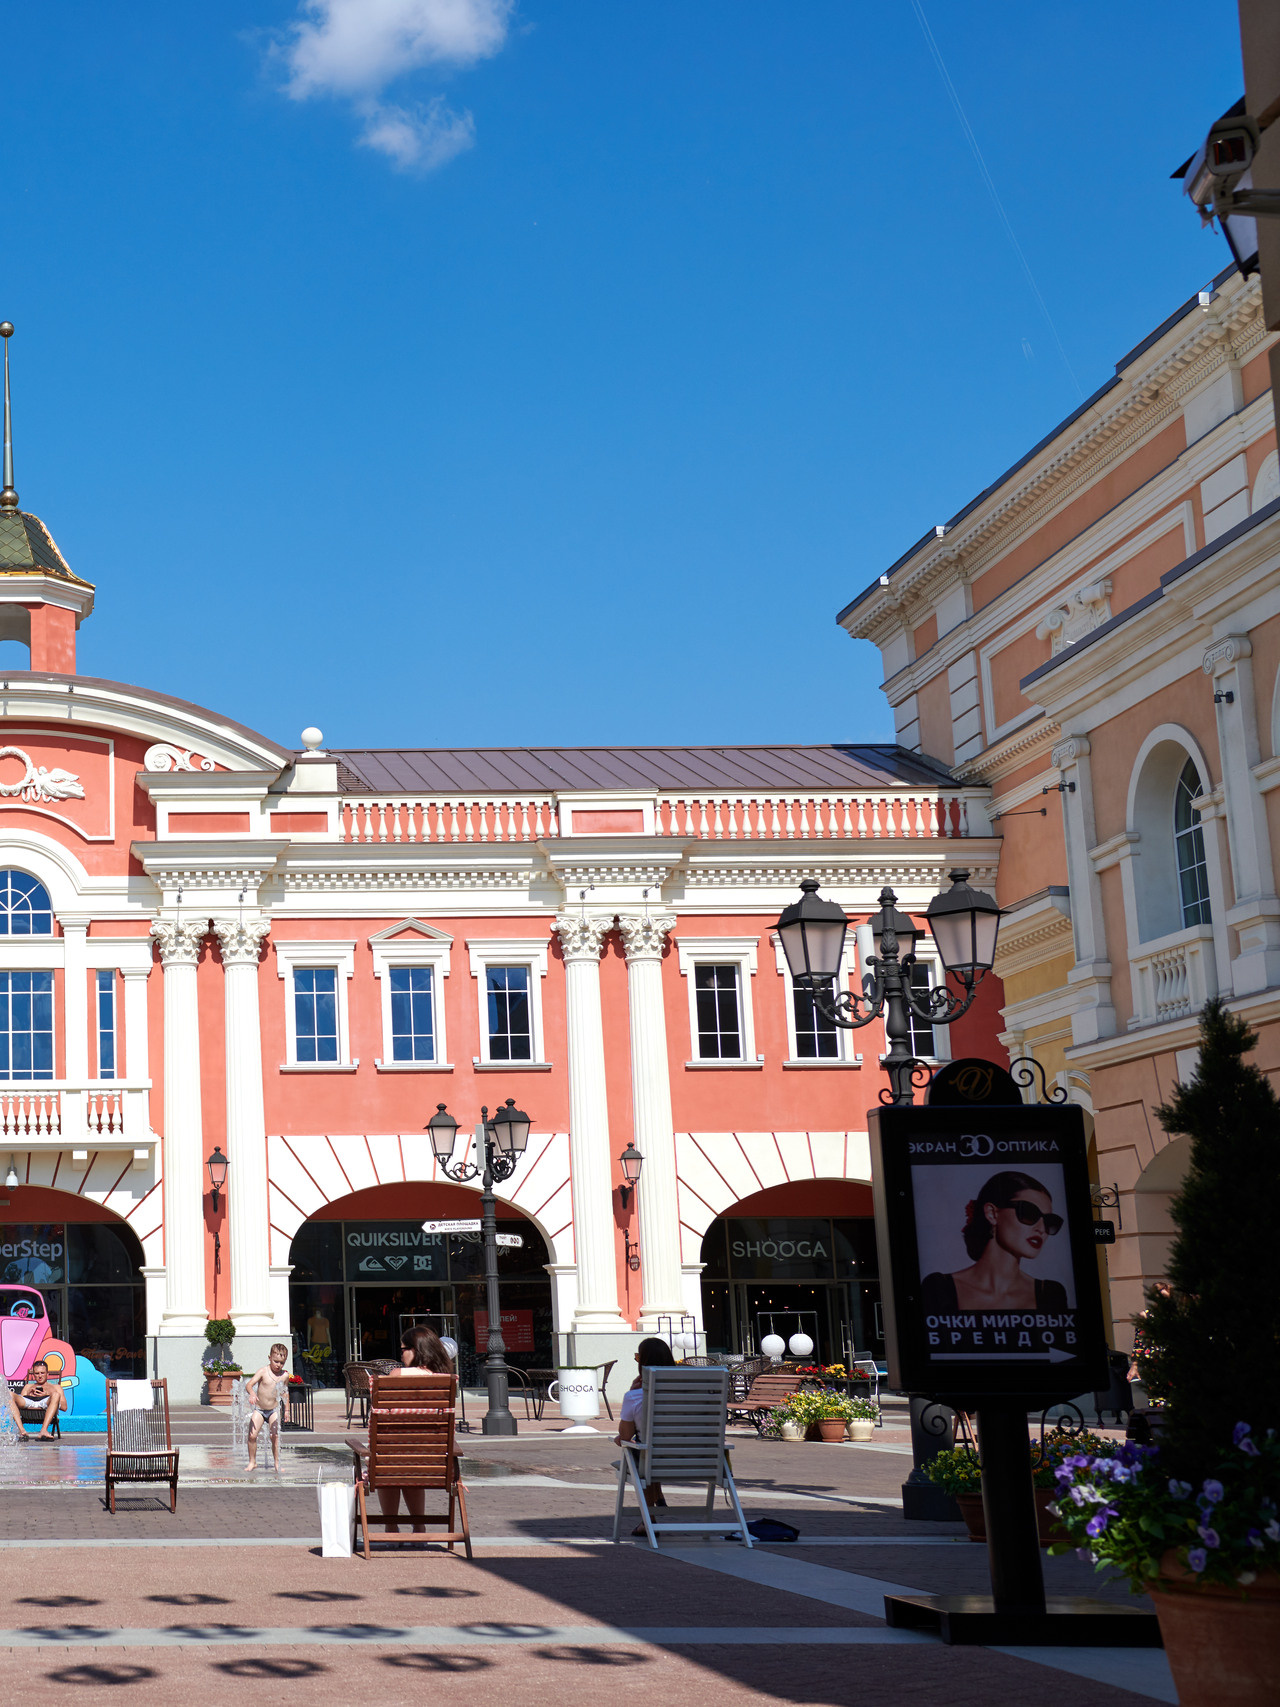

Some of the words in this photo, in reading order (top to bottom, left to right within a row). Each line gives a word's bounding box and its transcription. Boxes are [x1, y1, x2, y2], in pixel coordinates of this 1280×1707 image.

[908, 1141, 956, 1153] ЭКРАН
[996, 1139, 1060, 1152] ОПТИКА
[347, 1232, 443, 1247] QUIKSILVER
[732, 1239, 828, 1260] SHOOGA
[926, 1315, 977, 1328] ОЧКИ
[982, 1314, 1076, 1328] МИРОВЫХ
[928, 1331, 1077, 1347] БРЕНДОВ
[560, 1384, 594, 1393] SHOOGA
